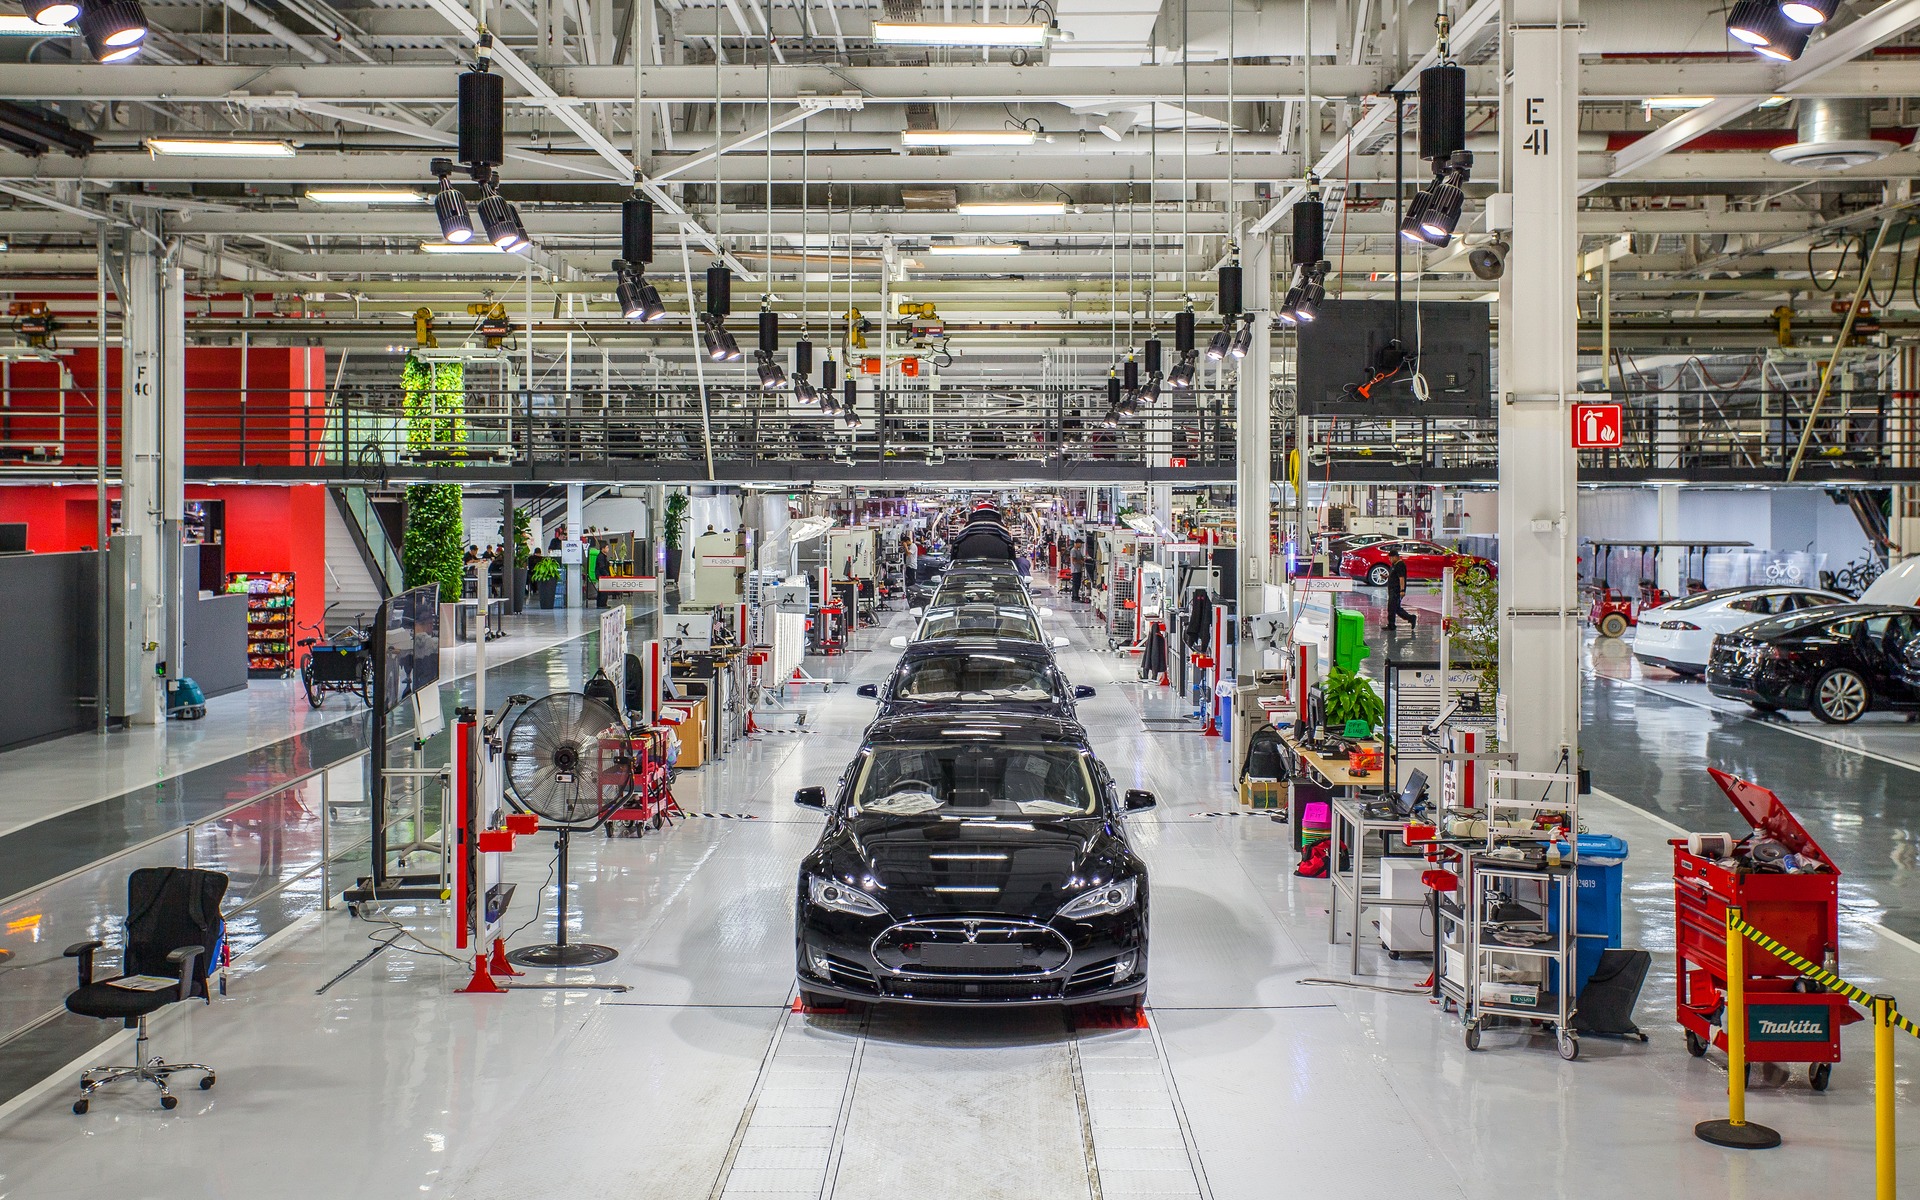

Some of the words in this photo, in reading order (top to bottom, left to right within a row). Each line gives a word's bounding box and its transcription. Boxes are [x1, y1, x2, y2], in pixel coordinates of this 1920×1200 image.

[1526, 97, 1544, 125] E
[1522, 128, 1549, 156] 41
[137, 366, 147, 380] F
[134, 382, 152, 396] 40
[1423, 673, 1435, 684] GA
[1758, 1020, 1823, 1034] Makita
